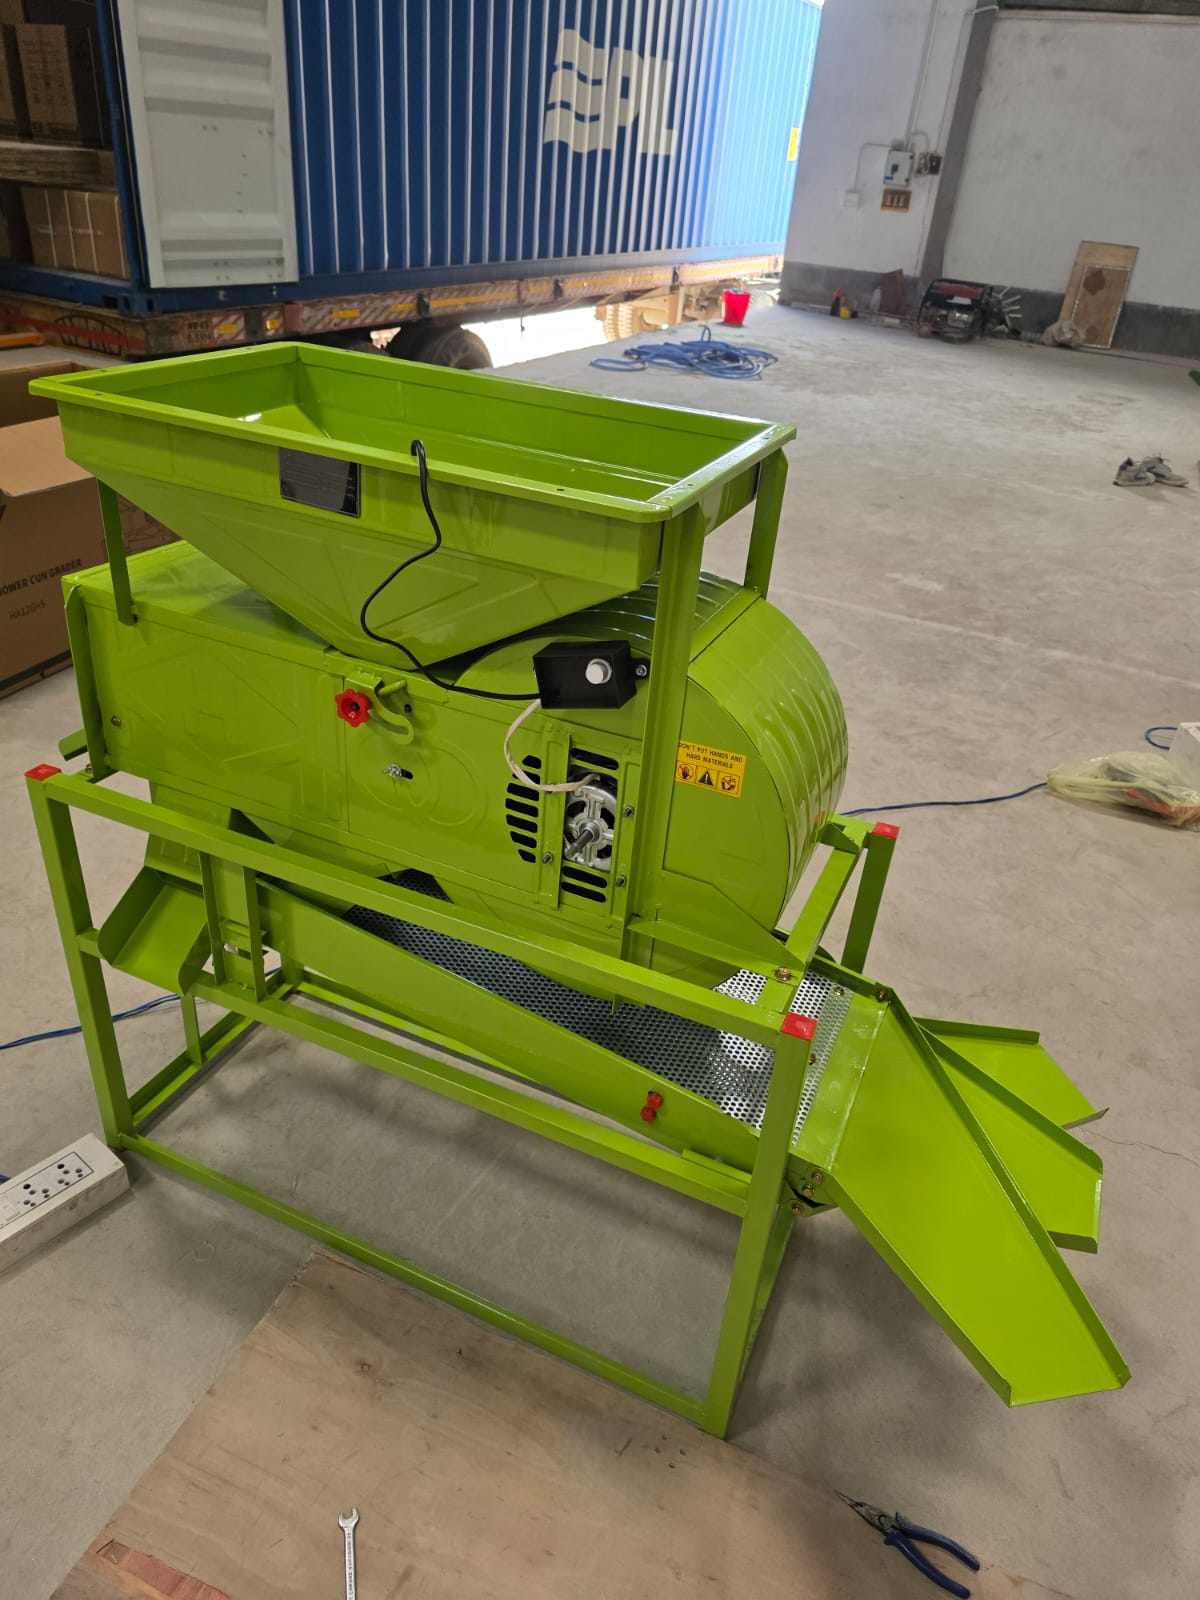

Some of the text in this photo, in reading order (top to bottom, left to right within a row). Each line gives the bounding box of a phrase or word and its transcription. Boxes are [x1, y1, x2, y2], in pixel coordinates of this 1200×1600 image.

[0, 578, 28, 597] OWER
[49, 558, 82, 578] GRADER
[679, 742, 743, 763] DON'T PUT HANDS AND
[686, 752, 734, 769] HARD MATERIALS
